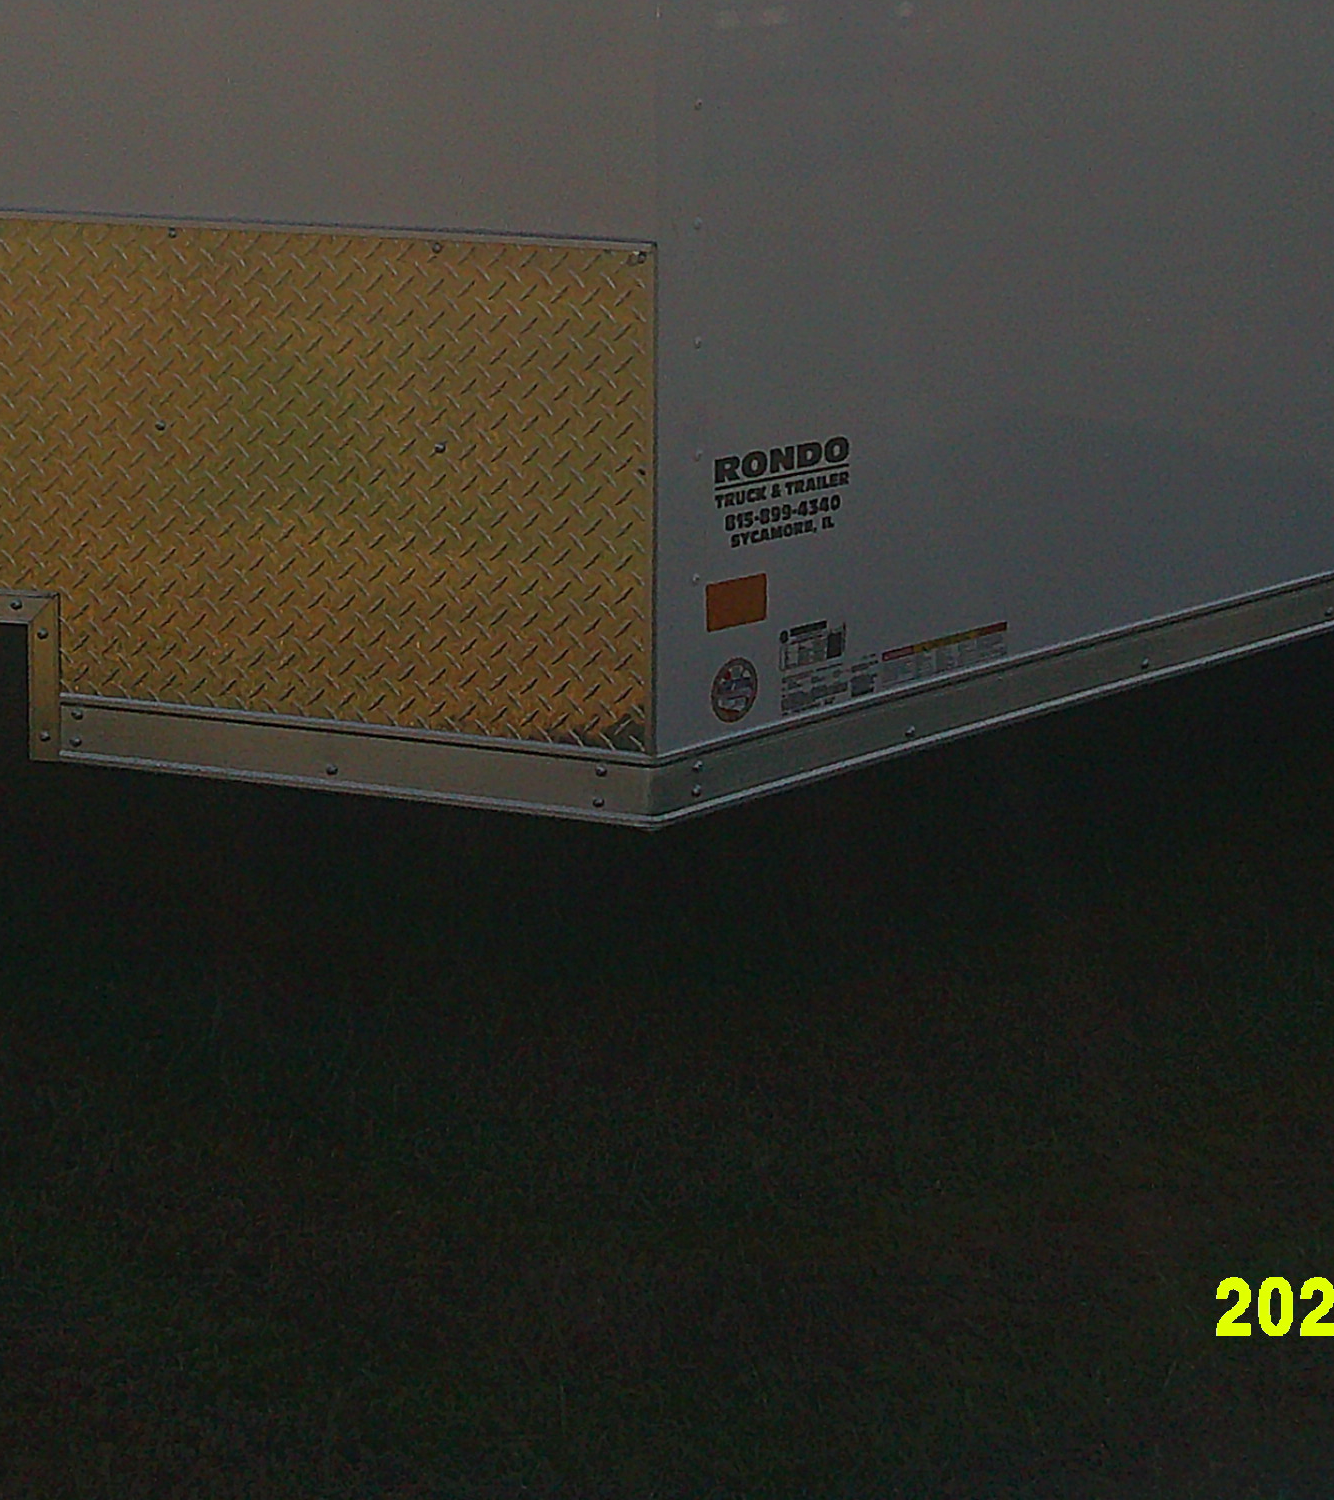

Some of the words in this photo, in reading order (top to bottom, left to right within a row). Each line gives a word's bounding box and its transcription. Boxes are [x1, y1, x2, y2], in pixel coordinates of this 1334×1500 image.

[714, 436, 850, 484] RONDO
[715, 486, 767, 509] TRUCK
[771, 483, 782, 499] &
[785, 471, 850, 496] TRAILER
[724, 494, 841, 531] 815-899-4340
[730, 519, 818, 548] SYCAMORE,
[821, 516, 835, 530] IL
